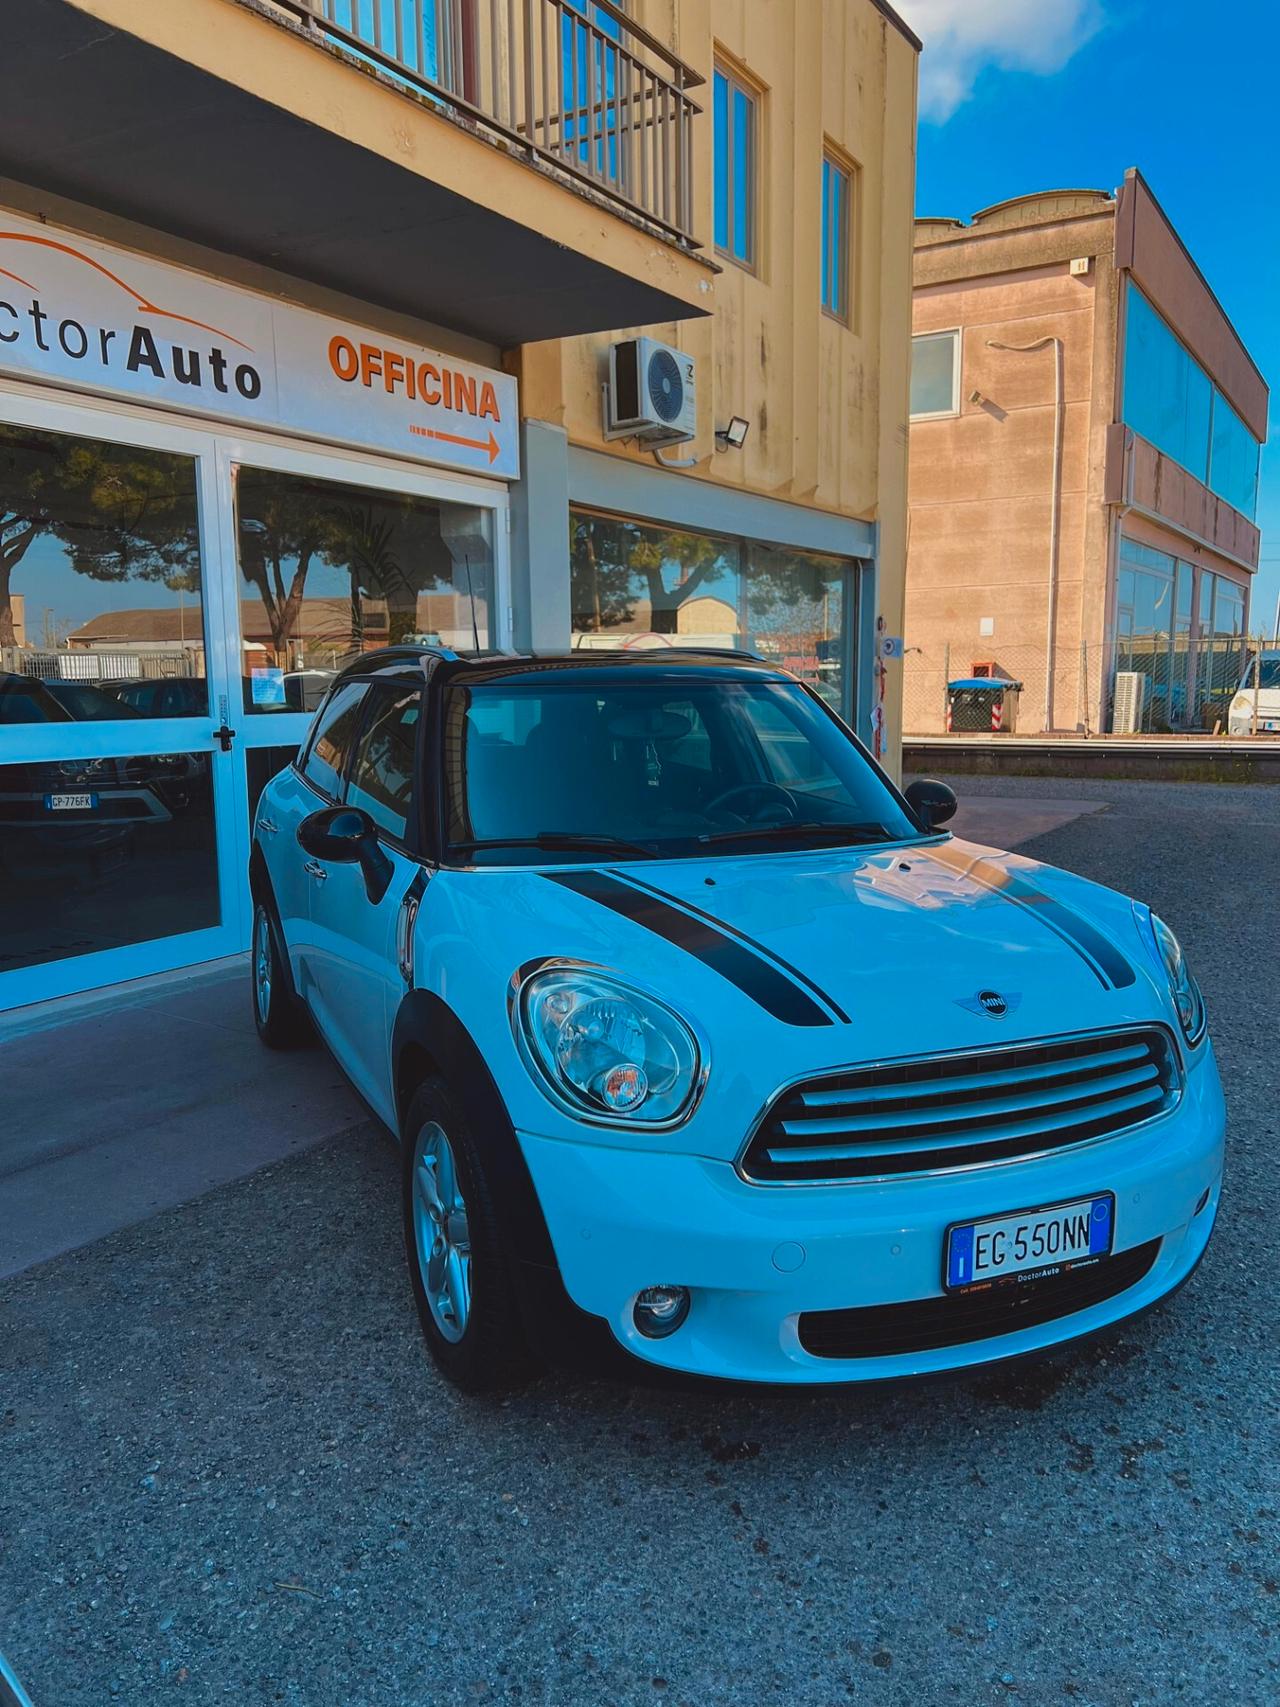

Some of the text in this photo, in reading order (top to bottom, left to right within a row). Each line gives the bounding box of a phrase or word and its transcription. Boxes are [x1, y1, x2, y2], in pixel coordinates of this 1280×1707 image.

[328, 335, 501, 422] OFFICINA
[981, 997, 1006, 1007] MINI
[1017, 1266, 1060, 1283] DoctorAuto
